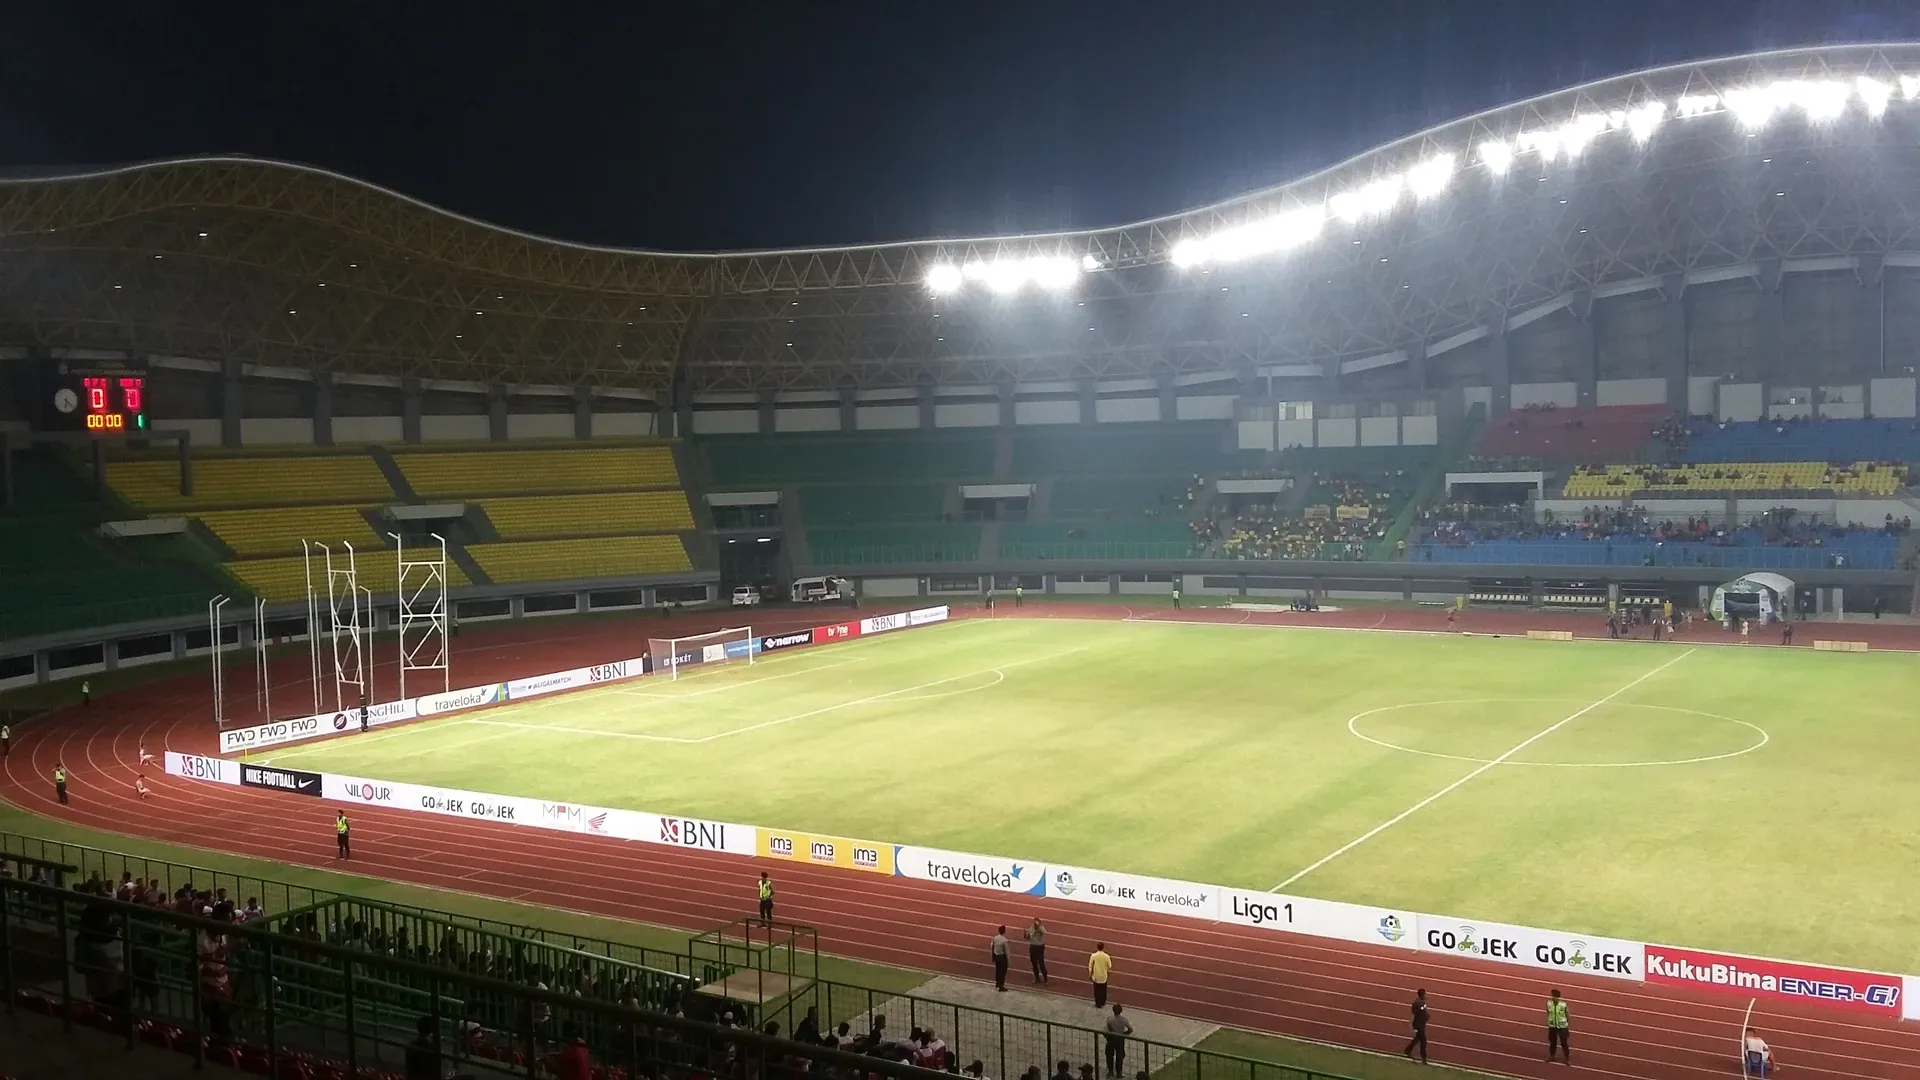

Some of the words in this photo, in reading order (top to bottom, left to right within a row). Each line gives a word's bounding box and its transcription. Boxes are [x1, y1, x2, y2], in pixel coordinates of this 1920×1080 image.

[91, 388, 104, 409] 0
[137, 414, 143, 428] 1
[880, 615, 896, 630] BNI
[775, 633, 810, 647] narrow
[603, 661, 627, 680] BNI
[435, 692, 482, 711] traveloka
[349, 703, 406, 722] SPNGHILL
[227, 729, 256, 745] FWD
[260, 724, 287, 739] FWD
[291, 718, 318, 733] FWD
[196, 757, 222, 781] BNI
[245, 768, 262, 786] NIKE
[262, 770, 297, 789] FOOTBALL
[344, 783, 391, 801] VILOUR
[542, 803, 582, 823] MPM
[683, 820, 725, 850] BNI
[927, 860, 1011, 888] traveloka
[1145, 890, 1200, 908] traveloka
[1233, 896, 1278, 924] Liga
[1284, 903, 1293, 923] 1
[1647, 954, 1777, 992] KukuBima
[1779, 976, 1900, 1008] ENER-G!
